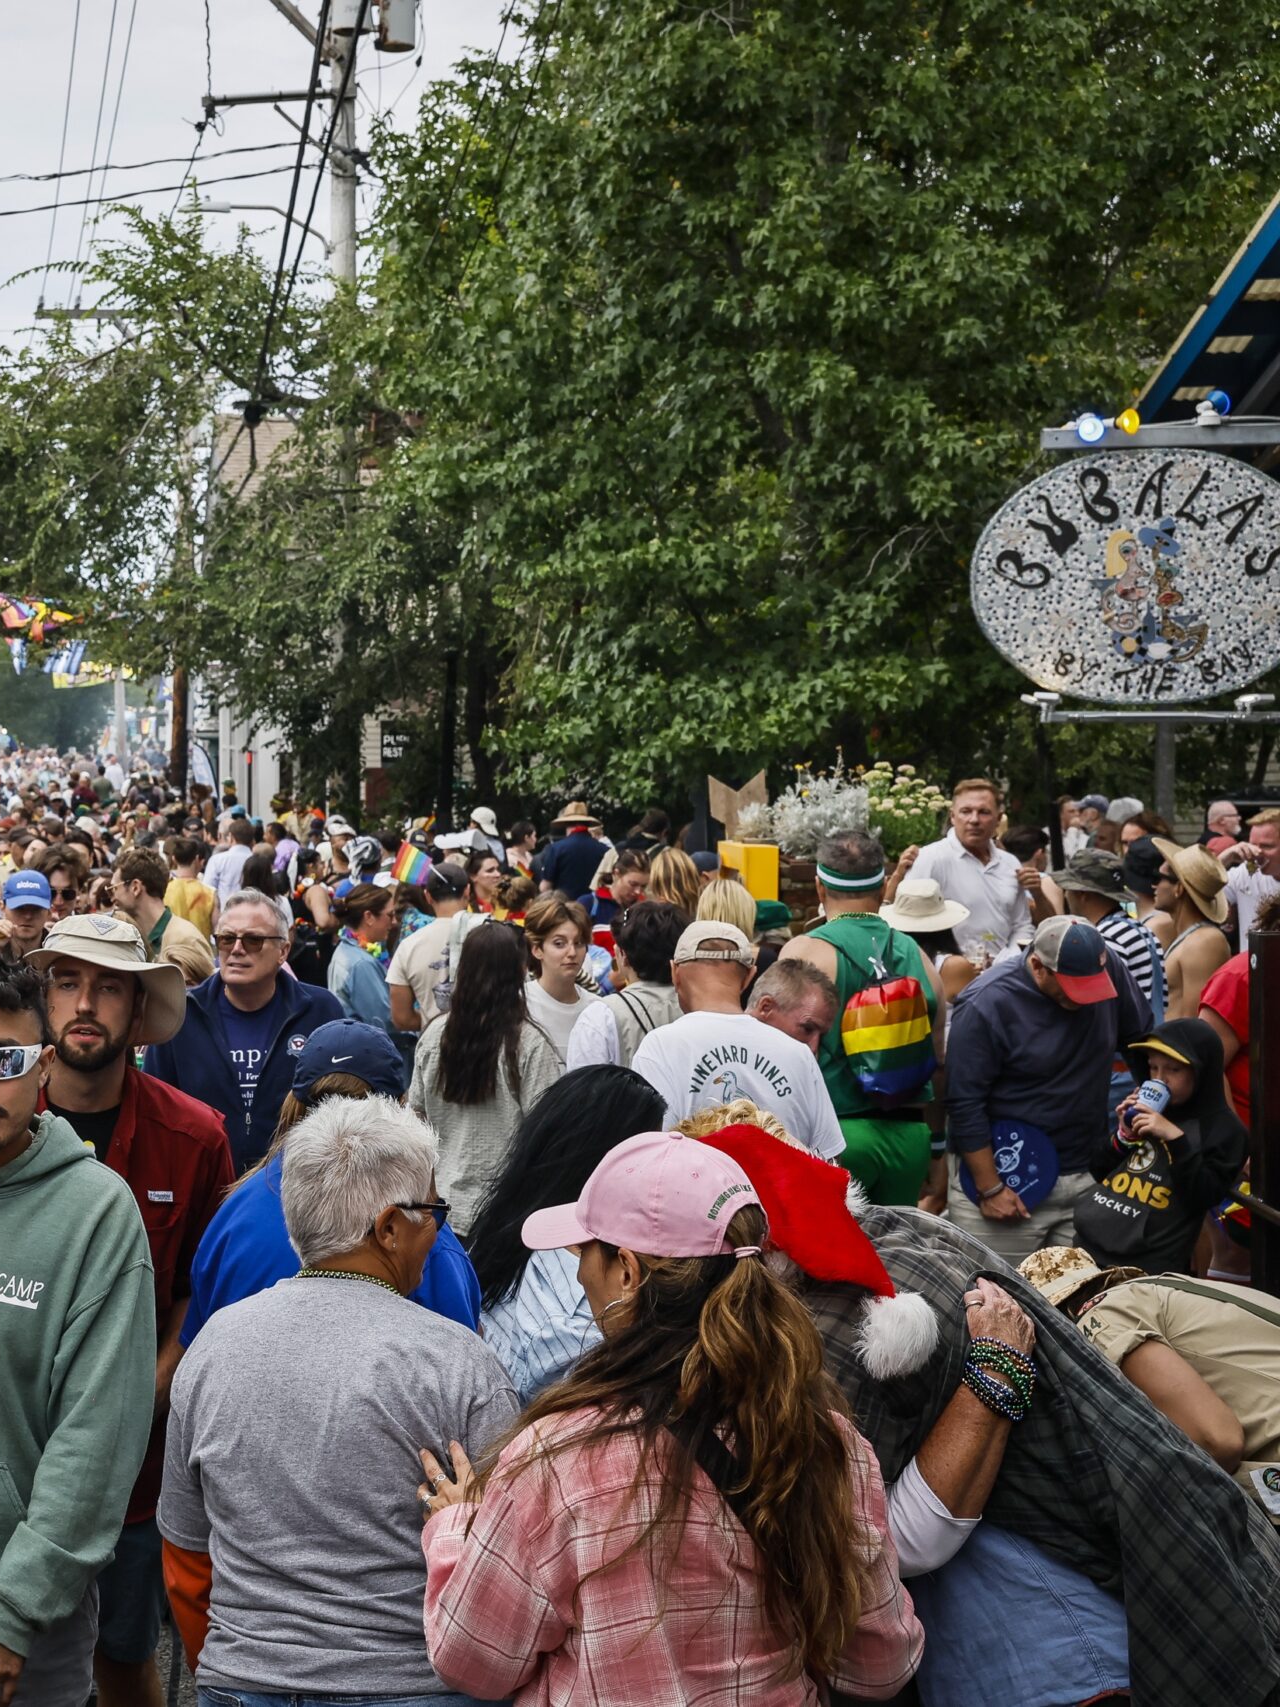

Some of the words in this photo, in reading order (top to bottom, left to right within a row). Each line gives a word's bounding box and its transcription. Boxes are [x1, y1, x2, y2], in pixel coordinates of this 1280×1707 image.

[1054, 650, 1101, 684] BY
[1114, 667, 1177, 696] THE
[1197, 638, 1254, 685] BAY
[16, 881, 40, 890] slalom
[688, 1044, 749, 1094] VINEYARD
[753, 1053, 793, 1098] VINES
[1092, 1191, 1141, 1219] HOCKEY
[1082, 1316, 1102, 1339] 44
